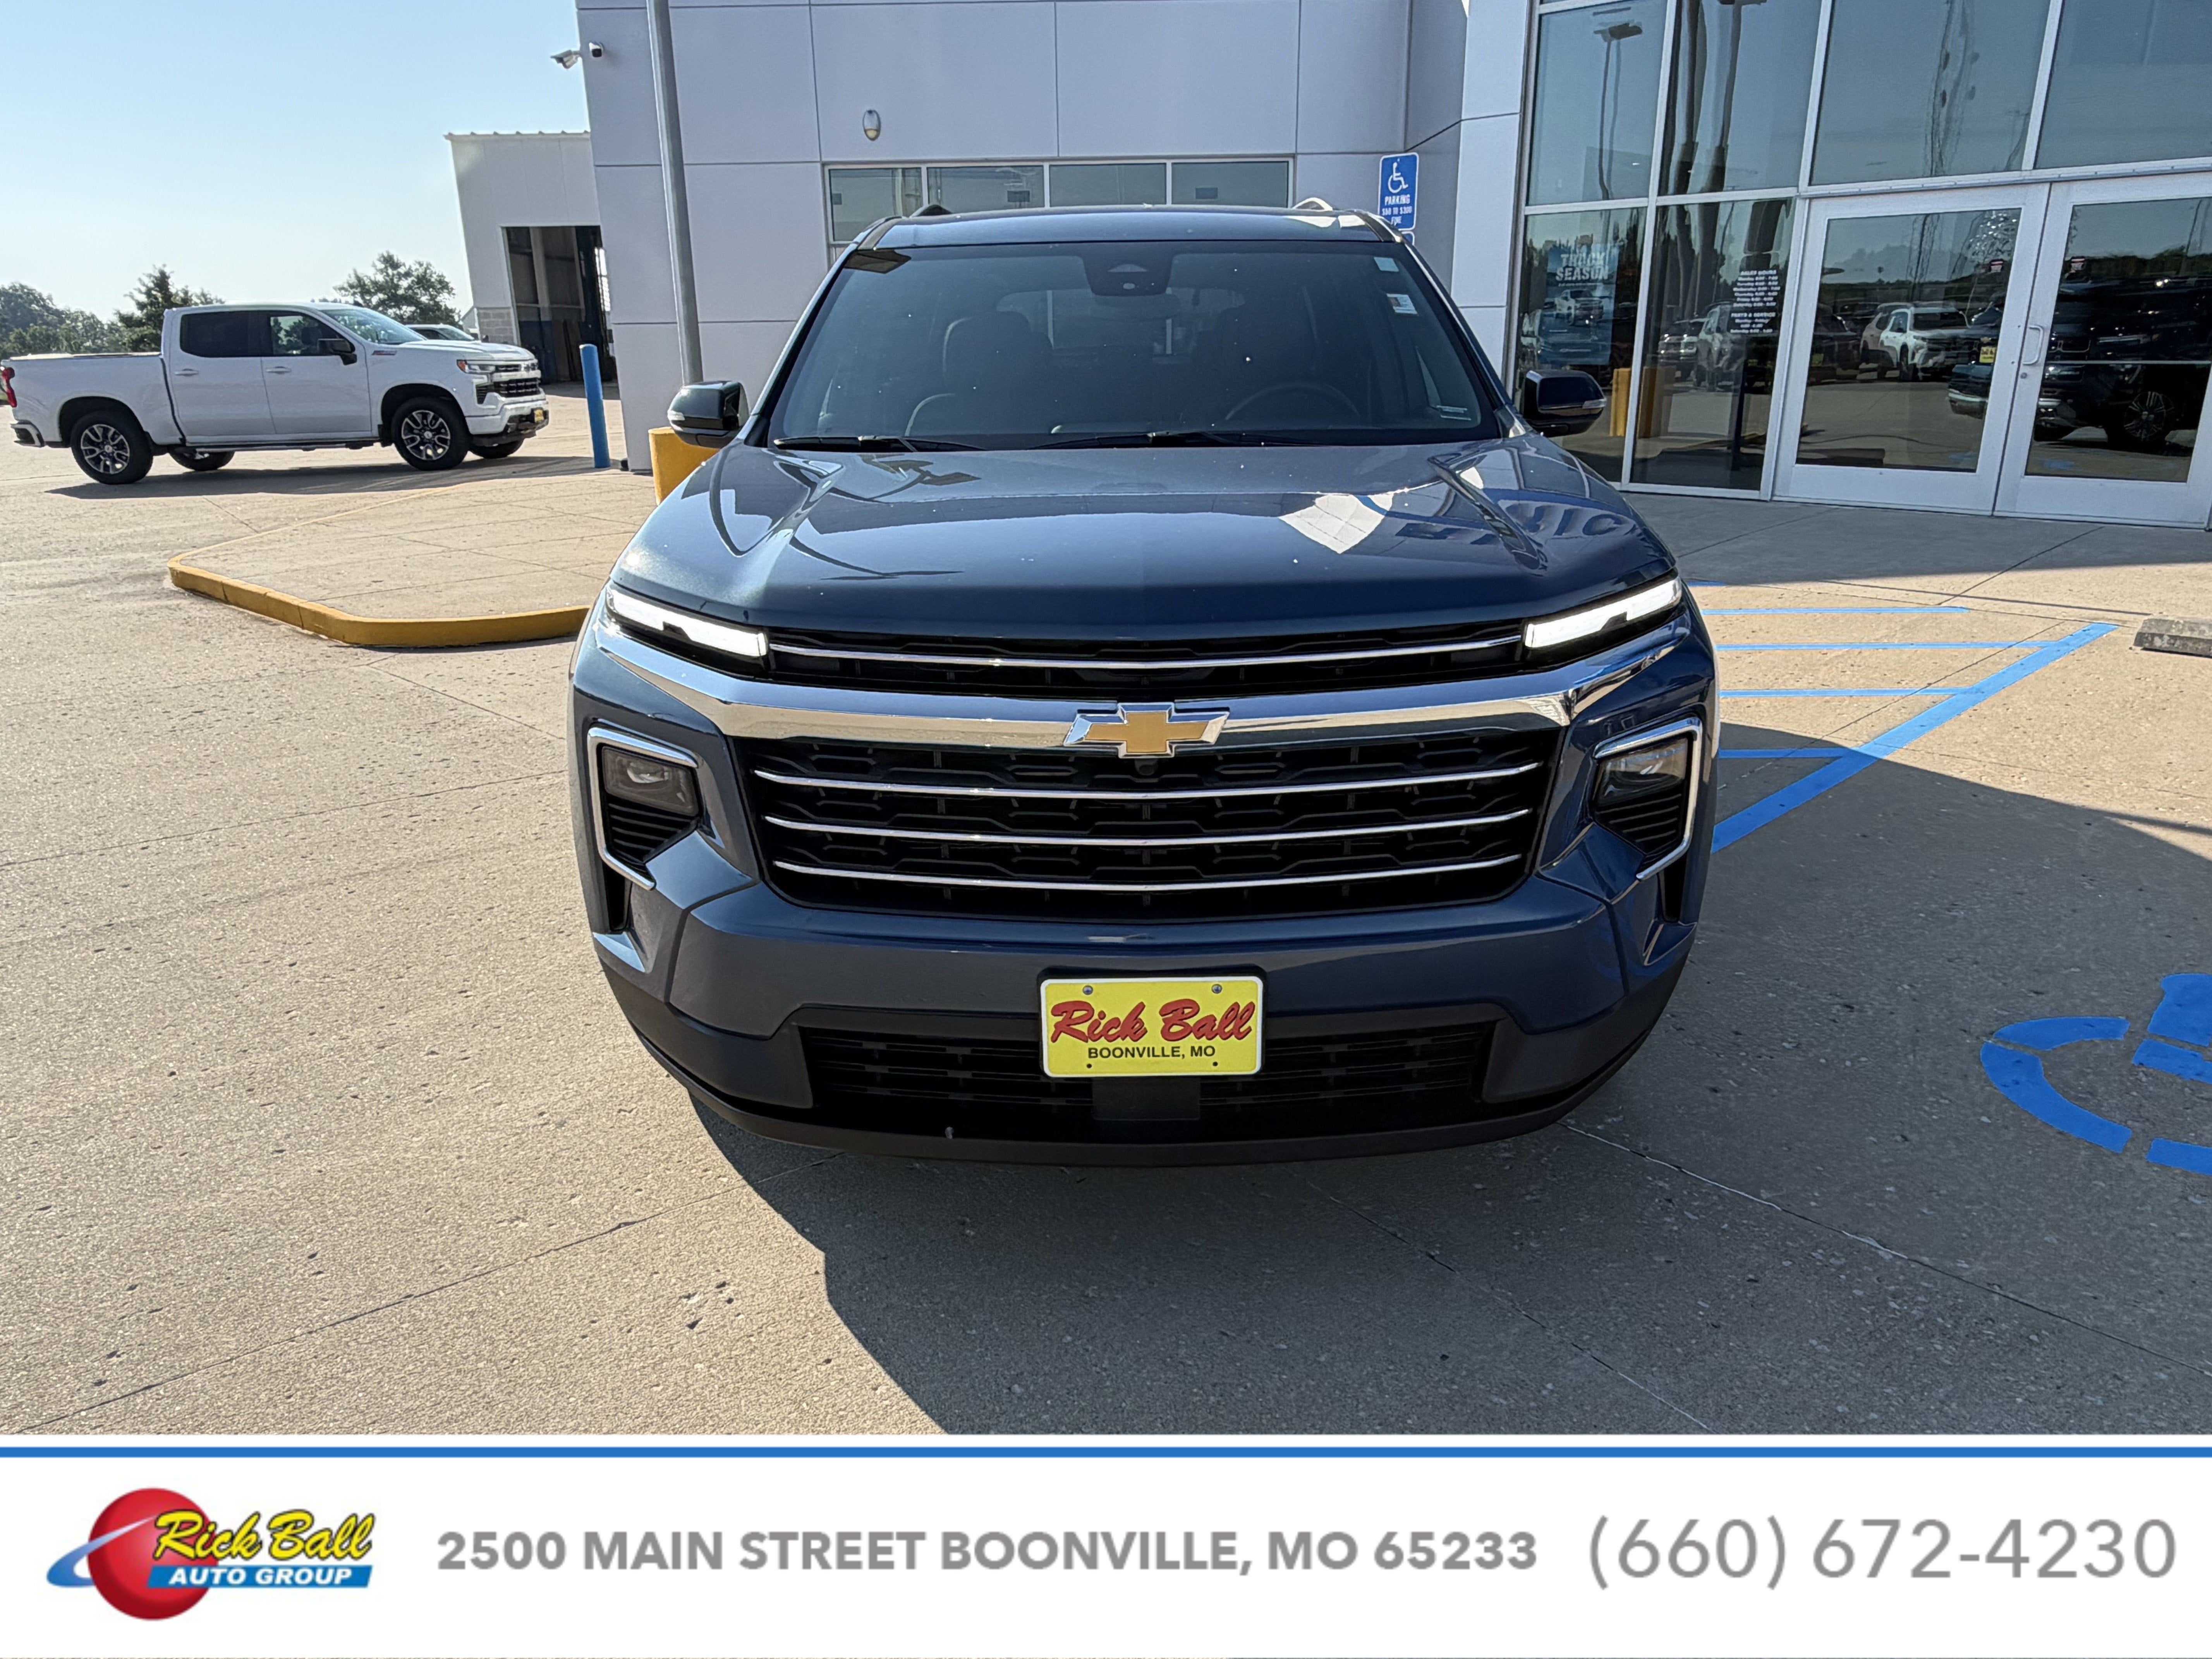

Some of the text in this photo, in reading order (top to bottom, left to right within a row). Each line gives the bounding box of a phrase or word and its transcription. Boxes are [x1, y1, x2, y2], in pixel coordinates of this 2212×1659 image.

[1385, 194, 1410, 206] PARKING
[1555, 265, 1608, 282] SEASON
[1051, 998, 1256, 1043] Rick Ball
[1088, 1045, 1216, 1060] BOONVILLE, MO
